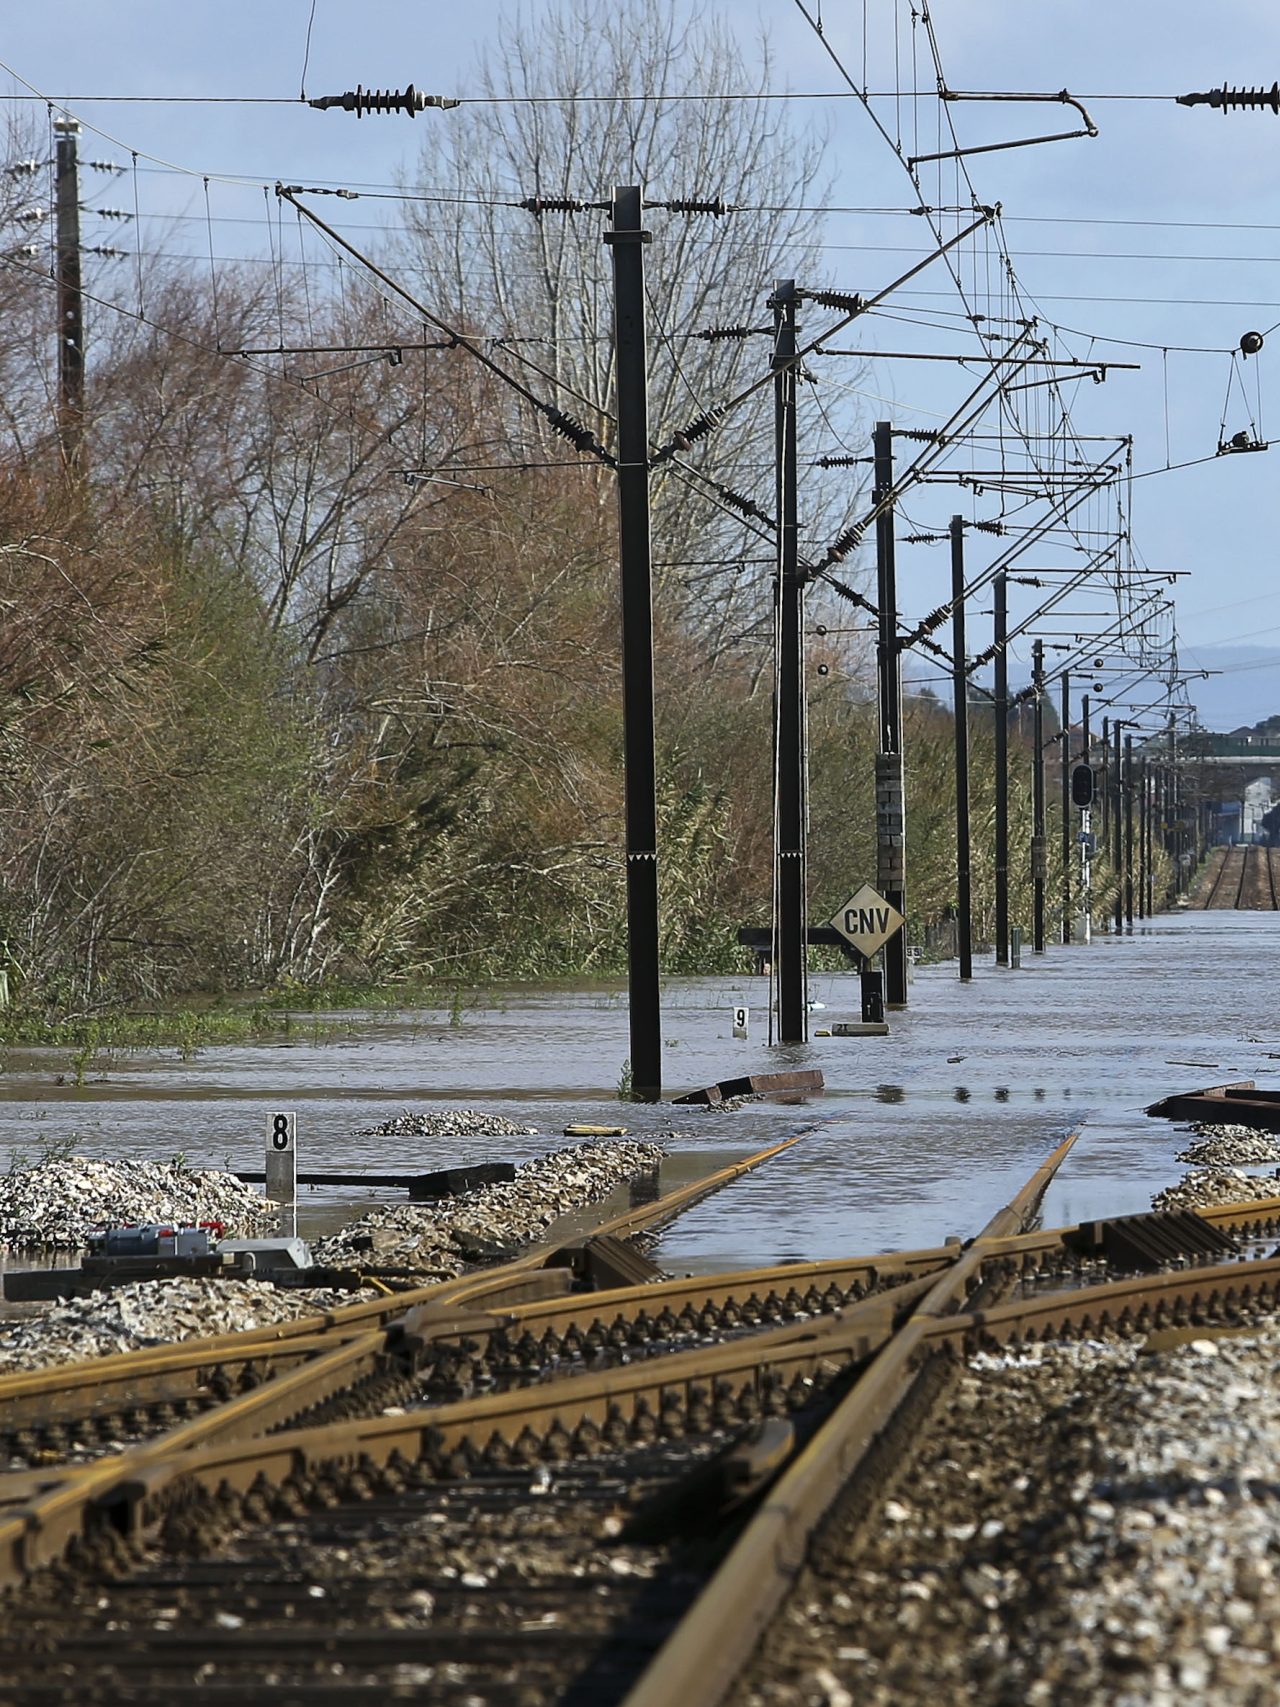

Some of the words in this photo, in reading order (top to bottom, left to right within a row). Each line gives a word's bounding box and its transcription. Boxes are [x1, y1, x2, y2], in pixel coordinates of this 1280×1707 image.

[844, 908, 890, 934] CNV
[736, 1009, 746, 1028] 9
[272, 1114, 288, 1150] 8
